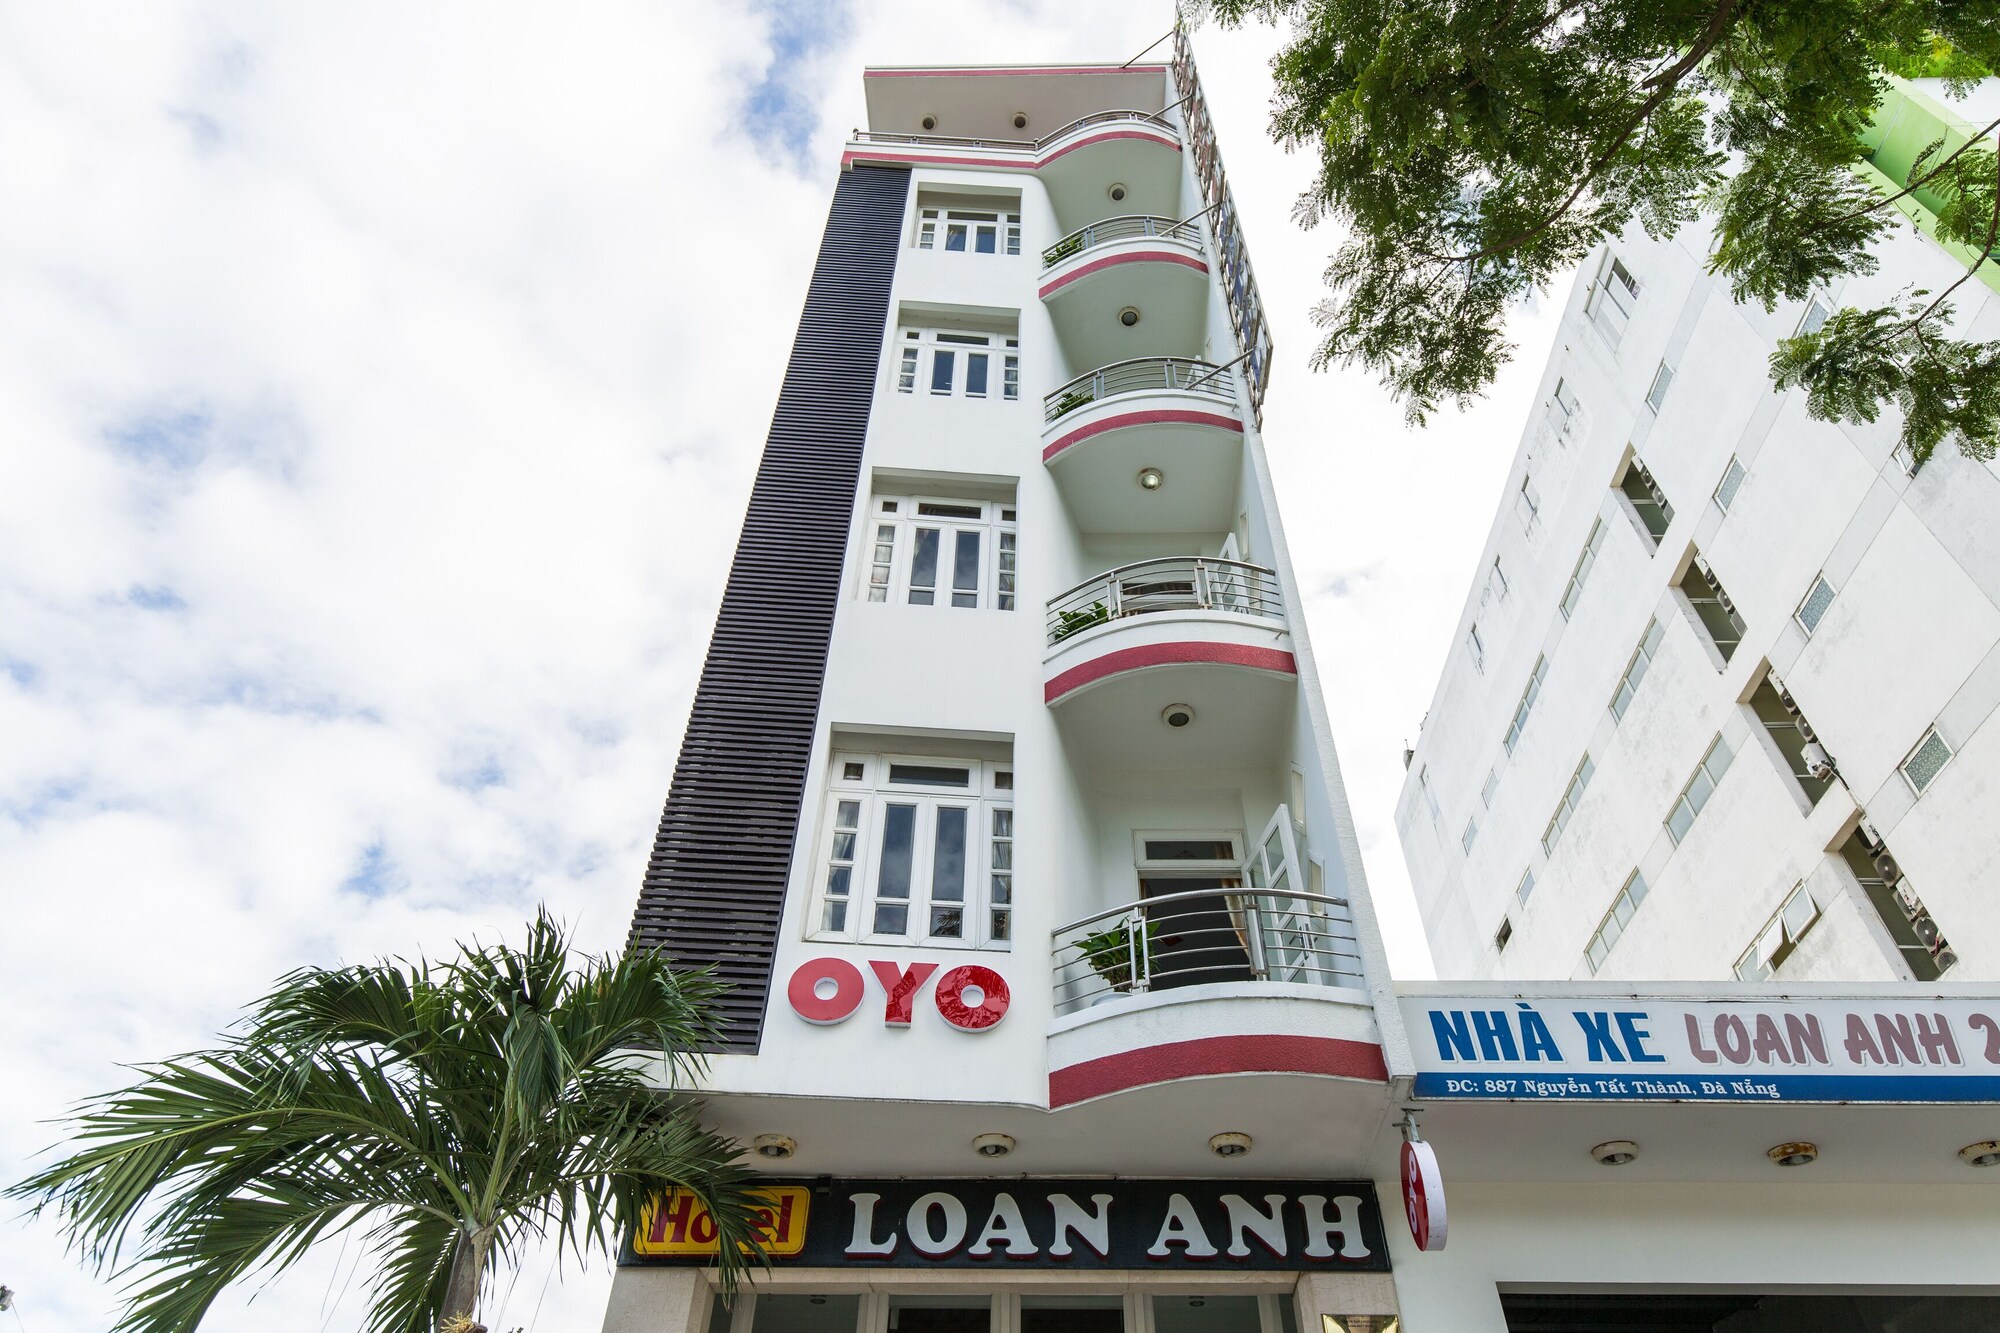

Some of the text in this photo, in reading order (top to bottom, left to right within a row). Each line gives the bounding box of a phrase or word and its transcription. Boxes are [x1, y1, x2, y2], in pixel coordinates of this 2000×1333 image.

[787, 957, 1011, 1034] OYO
[1428, 1003, 1565, 1063] NHÀ
[1572, 1011, 1668, 1064] XE
[1684, 1013, 1831, 1065] LOAN
[1843, 1013, 1962, 1065] ANH
[1446, 1077, 1780, 1099] ĐC: 887 Nguyễn Tất Thành, Đà Nẵng
[647, 1194, 796, 1245] Hoel
[1408, 1149, 1419, 1234] OYO
[844, 1192, 1372, 1262] LOAN ANH
